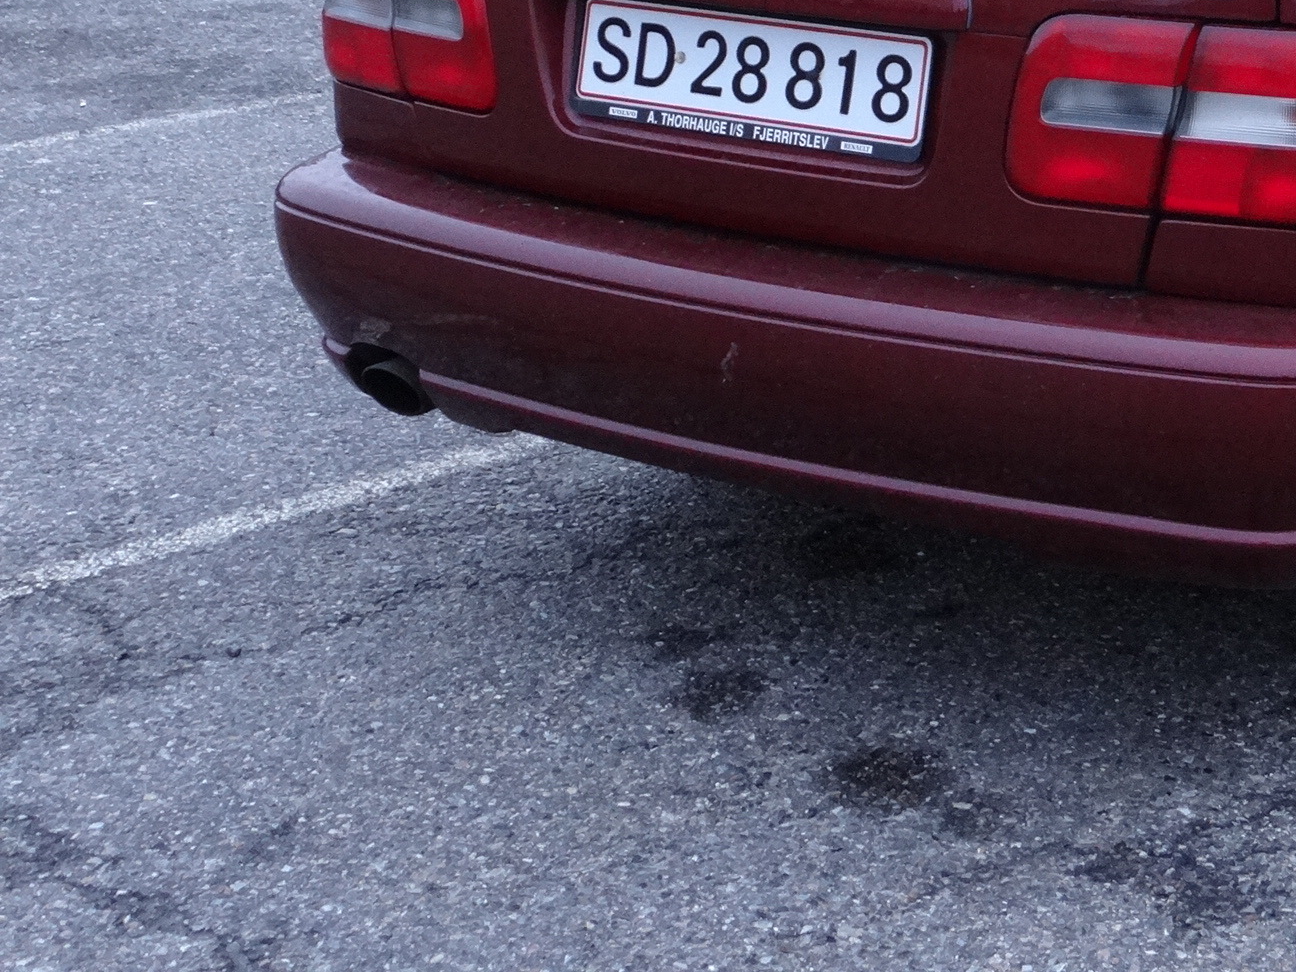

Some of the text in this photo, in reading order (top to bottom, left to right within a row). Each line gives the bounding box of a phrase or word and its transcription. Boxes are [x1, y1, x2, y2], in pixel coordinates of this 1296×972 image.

[592, 16, 913, 123] SD 28 818
[647, 111, 658, 124] A.
[661, 113, 727, 135] THORHAUGE
[752, 126, 829, 150] FJERRITSLEV
